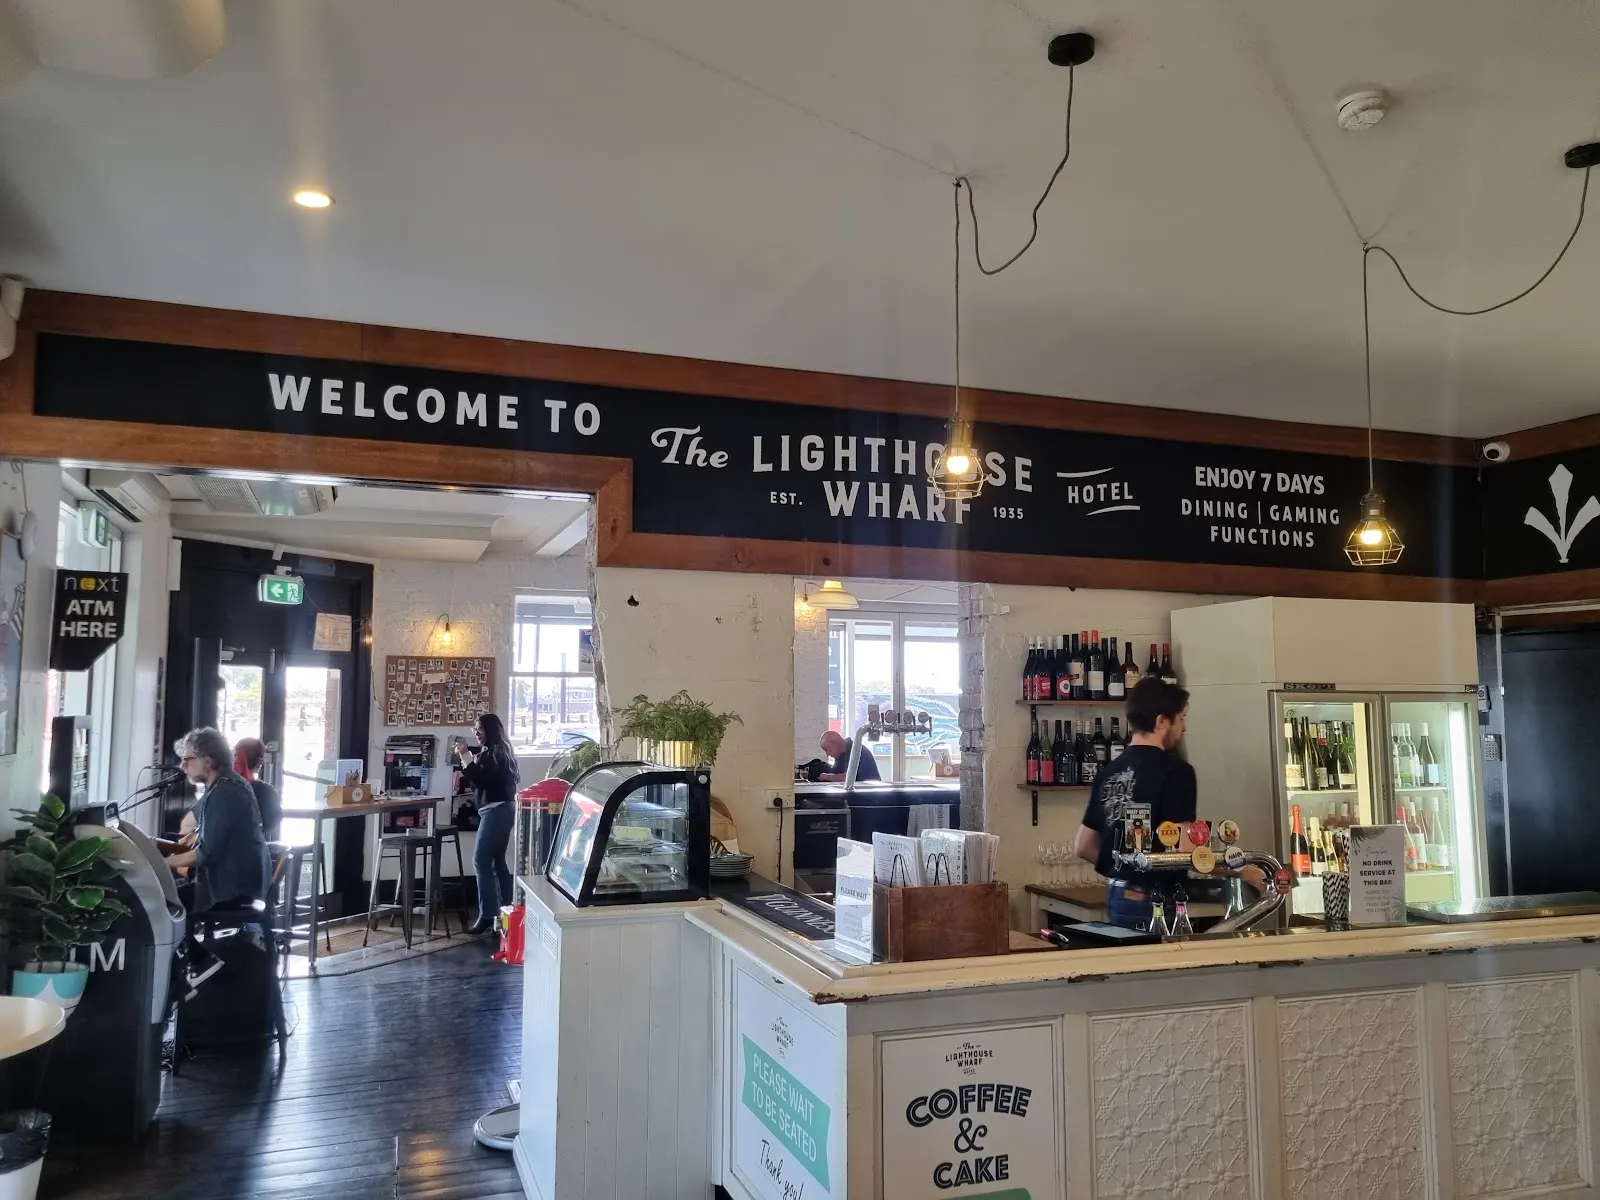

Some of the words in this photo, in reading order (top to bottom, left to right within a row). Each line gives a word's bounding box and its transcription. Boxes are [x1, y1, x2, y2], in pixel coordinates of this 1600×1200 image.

[268, 373, 519, 431] WELCOME
[544, 399, 601, 437] TO
[651, 425, 730, 469] The
[1067, 481, 1134, 504] HOTEL
[1195, 466, 1256, 490] ENJOY
[1260, 472, 1272, 493] 7
[1276, 472, 1325, 495] DAYS
[770, 491, 804, 506] EST.
[823, 480, 973, 525] WHARF
[992, 506, 1024, 520] 1935
[1181, 498, 1248, 519] DINING
[1269, 504, 1340, 525] GAMING
[1210, 525, 1315, 548] FUNCTIONS
[66, 599, 115, 617] ATM
[59, 620, 118, 639] HERE
[1359, 869, 1386, 877] SERVICE
[1373, 859, 1393, 867] DRINK
[840, 886, 856, 897] PLEASE
[857, 890, 868, 900] WAIT
[945, 1049, 993, 1063] LIGHTHOUSE
[956, 1058, 983, 1068] WHARF
[753, 1053, 787, 1102] PLEASE
[788, 1083, 815, 1126] WAIT
[906, 1083, 1032, 1128] COFFEE
[751, 1080, 764, 1109] TO
[765, 1095, 777, 1125] BE
[779, 1107, 817, 1163] SEATED
[954, 1117, 988, 1154] &
[760, 1139, 784, 1185] Thank
[933, 1154, 1010, 1190] CAKE
